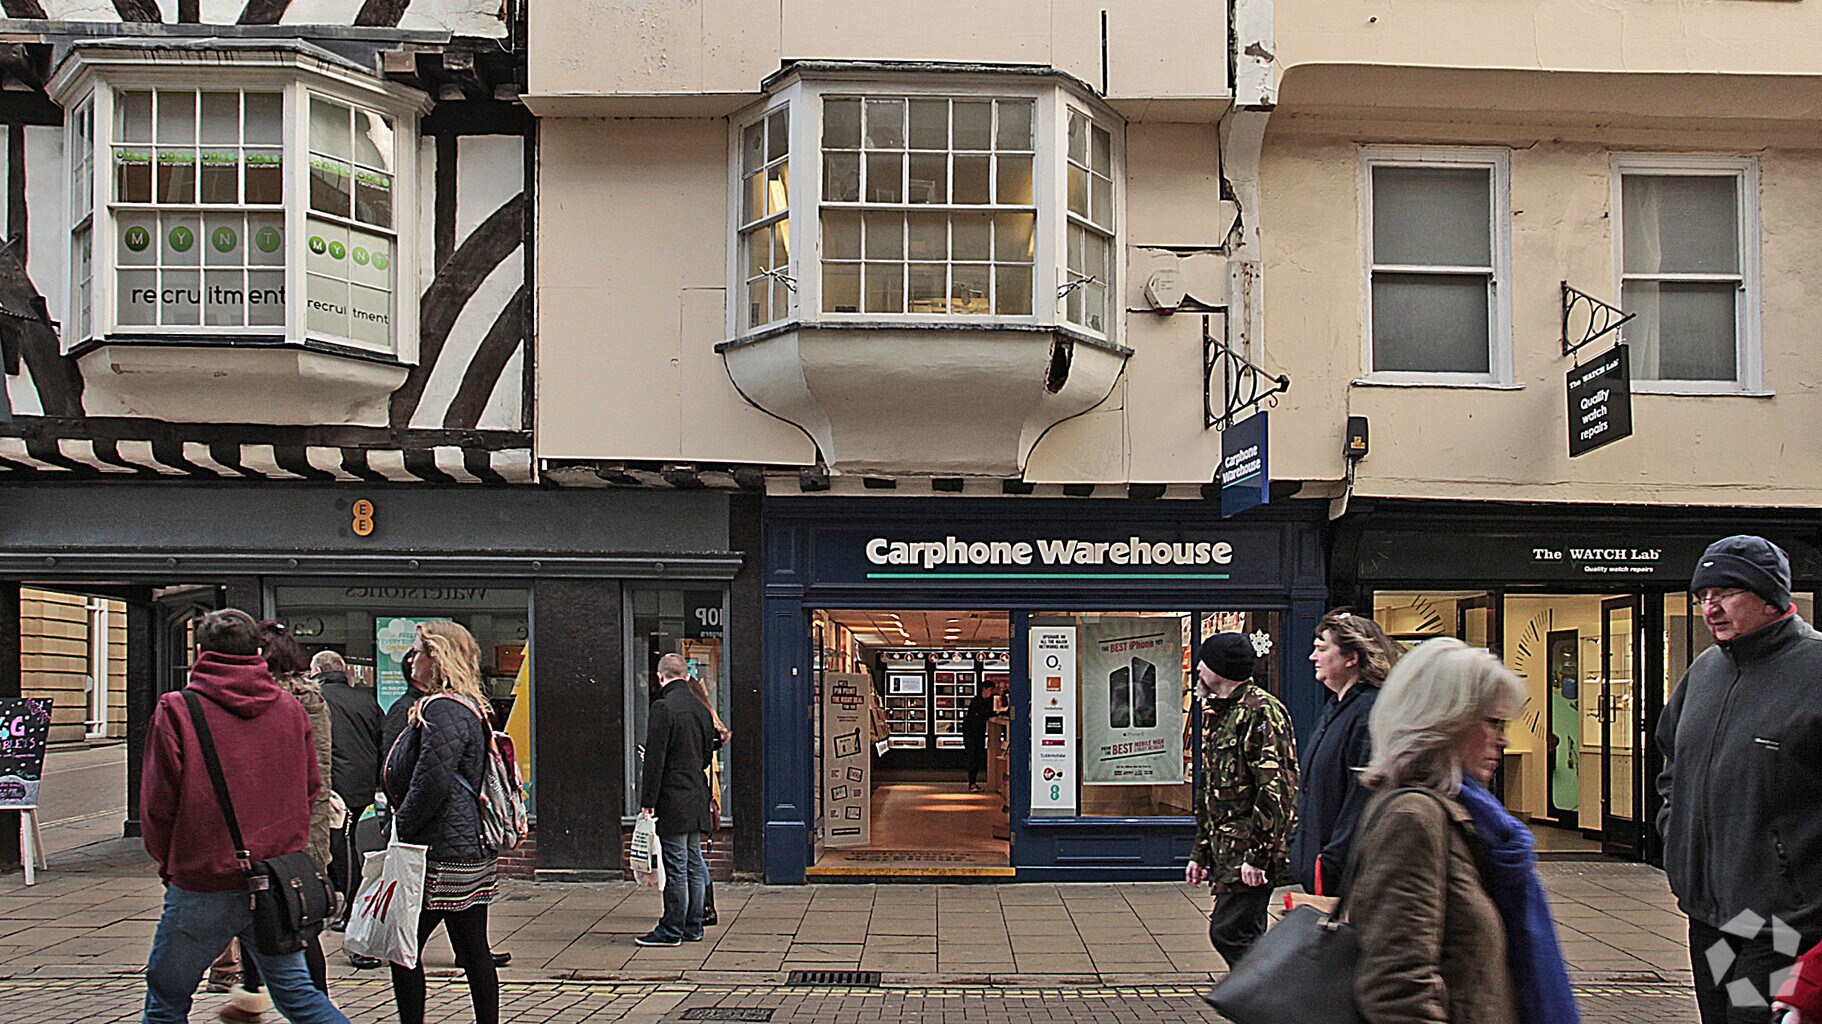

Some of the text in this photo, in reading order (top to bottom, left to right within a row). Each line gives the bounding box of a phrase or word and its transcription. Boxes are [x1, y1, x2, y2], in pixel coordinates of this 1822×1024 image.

[131, 285, 286, 305] recruitment
[307, 298, 389, 325] recruitment
[1569, 379, 1582, 389] The
[1582, 365, 1606, 382] WATCH
[1580, 389, 1610, 410] Quality
[1581, 404, 1608, 424] watch
[1580, 420, 1609, 441] repairs
[1224, 445, 1258, 469] Carphone
[1222, 458, 1261, 484] Warehouse
[865, 536, 1233, 569] Carphone Warehouse
[1532, 548, 1563, 560] The
[1569, 548, 1628, 560] WATCH
[1583, 565, 1654, 574] Quality watch repairs
[1110, 641, 1128, 653] BEST
[1129, 640, 1154, 651] iPhone
[0, 737, 36, 750] BLETS
[1112, 742, 1133, 755] BEST
